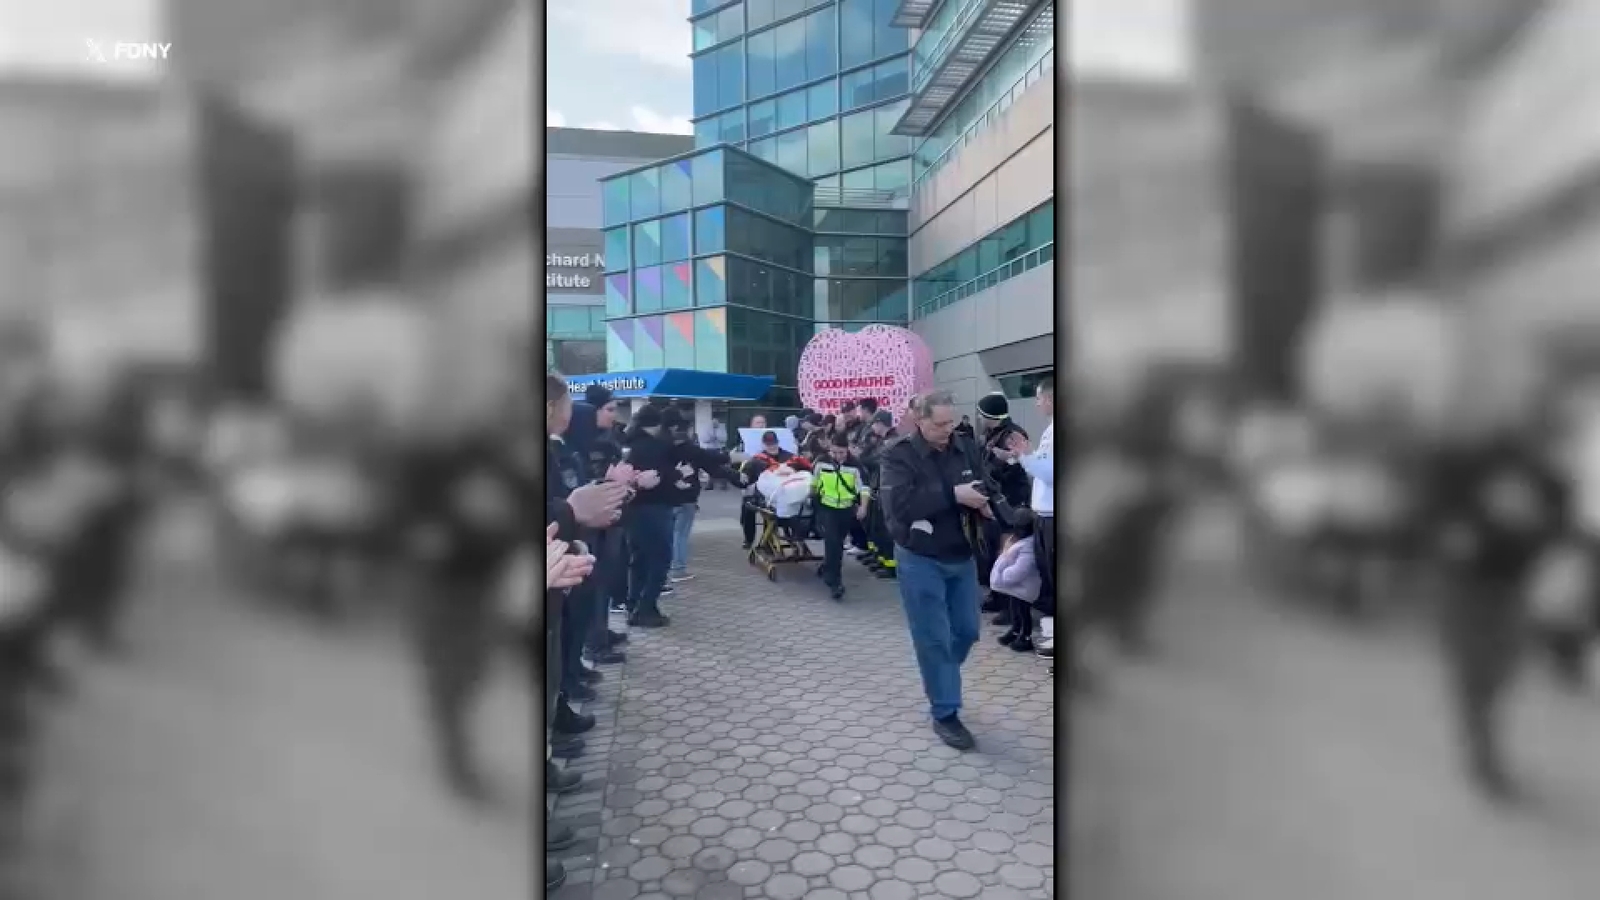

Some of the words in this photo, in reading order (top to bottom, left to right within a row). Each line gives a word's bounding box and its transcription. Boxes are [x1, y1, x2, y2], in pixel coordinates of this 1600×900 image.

[814, 379, 842, 390] GOOD
[843, 377, 882, 388] HEALTH
[884, 375, 895, 386] IS
